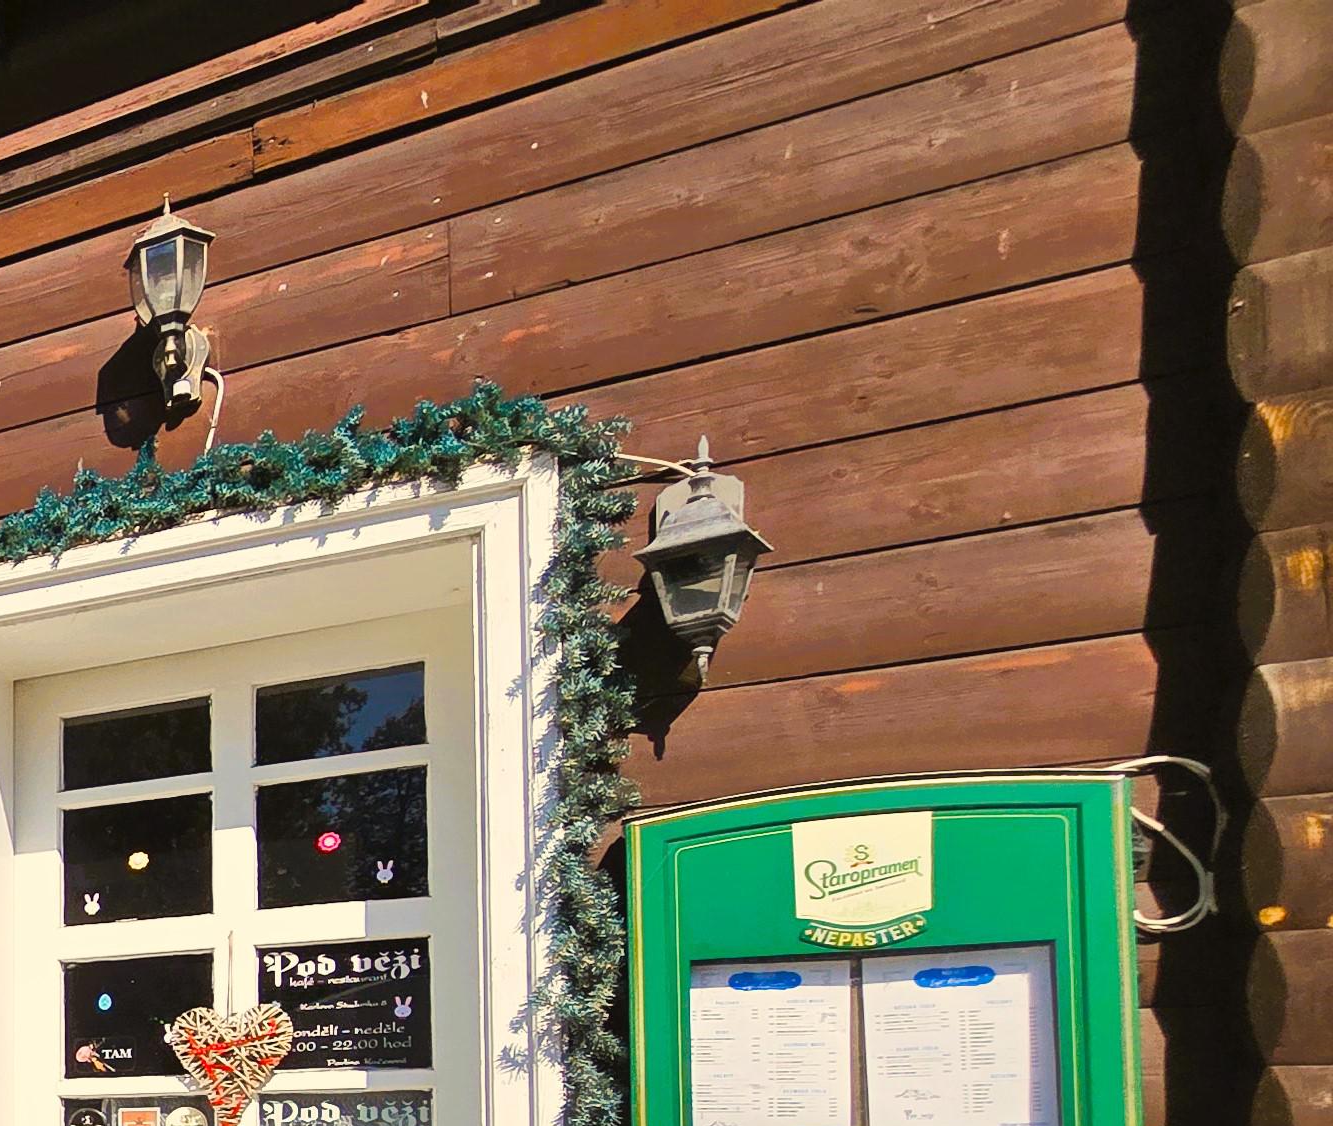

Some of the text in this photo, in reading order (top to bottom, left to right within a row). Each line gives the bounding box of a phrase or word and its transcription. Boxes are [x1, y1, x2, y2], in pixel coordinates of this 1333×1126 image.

[804, 858, 921, 900] Staropramen
[811, 920, 919, 947] NEPASTER
[263, 948, 422, 988] Pod věži
[292, 1023, 339, 1038] ondělí
[354, 1021, 406, 1035] neděle
[101, 1048, 133, 1060] TAM
[332, 1039, 379, 1051] 22.00
[383, 1036, 412, 1049] hod
